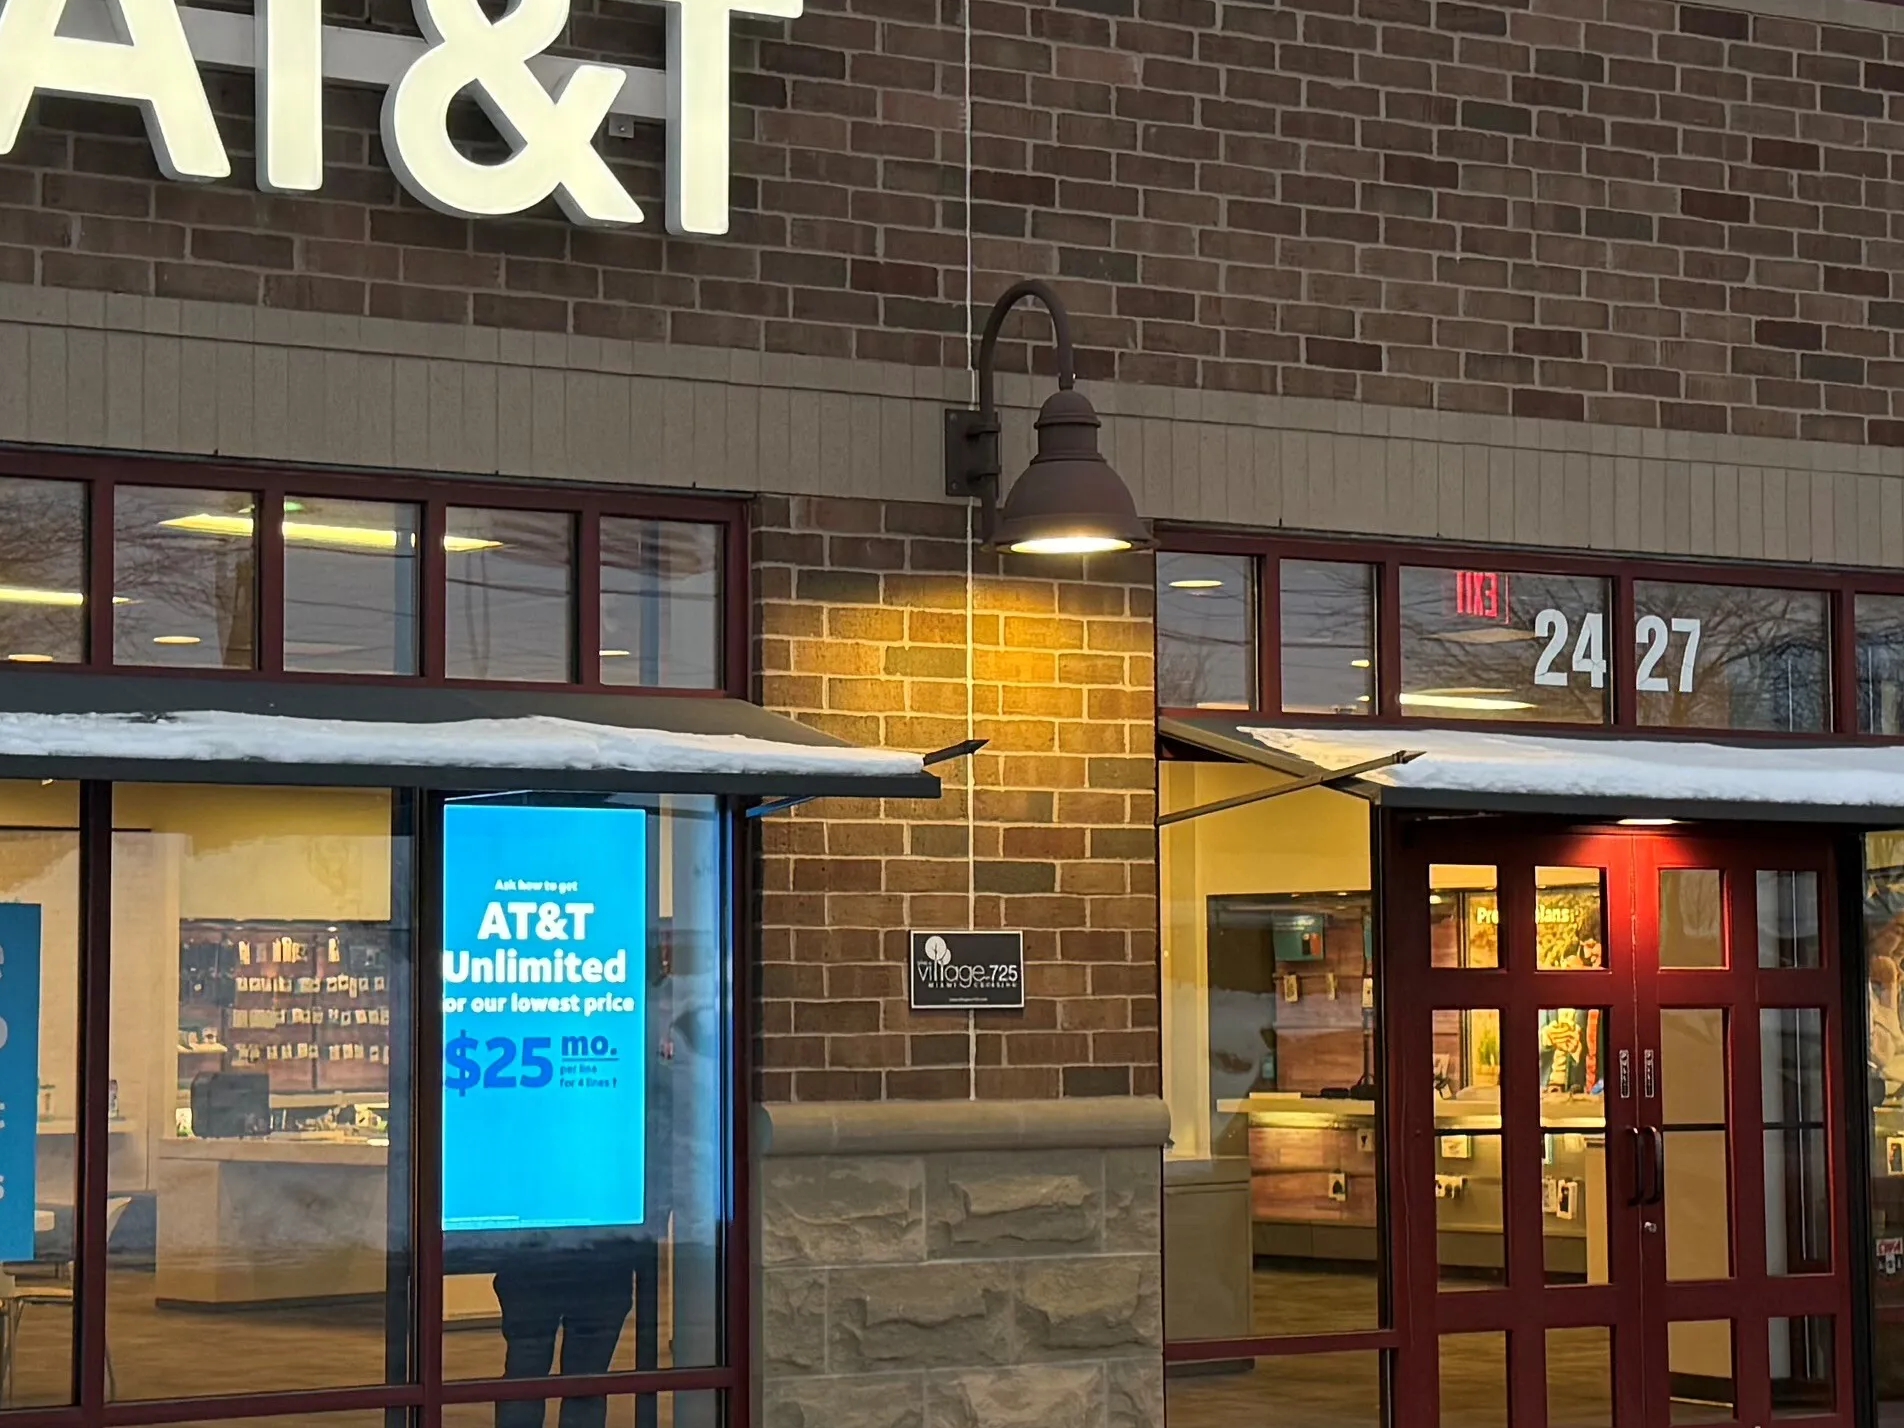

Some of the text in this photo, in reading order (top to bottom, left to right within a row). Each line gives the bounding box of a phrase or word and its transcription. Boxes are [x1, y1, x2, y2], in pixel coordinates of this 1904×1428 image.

[1534, 609, 1701, 692] 24 27
[495, 879, 578, 894] Ask how to get
[477, 902, 594, 940] AT&T
[443, 948, 626, 983] Unlimited
[442, 992, 635, 1017] or our lowest price
[444, 1029, 617, 1097] $25 mo.
